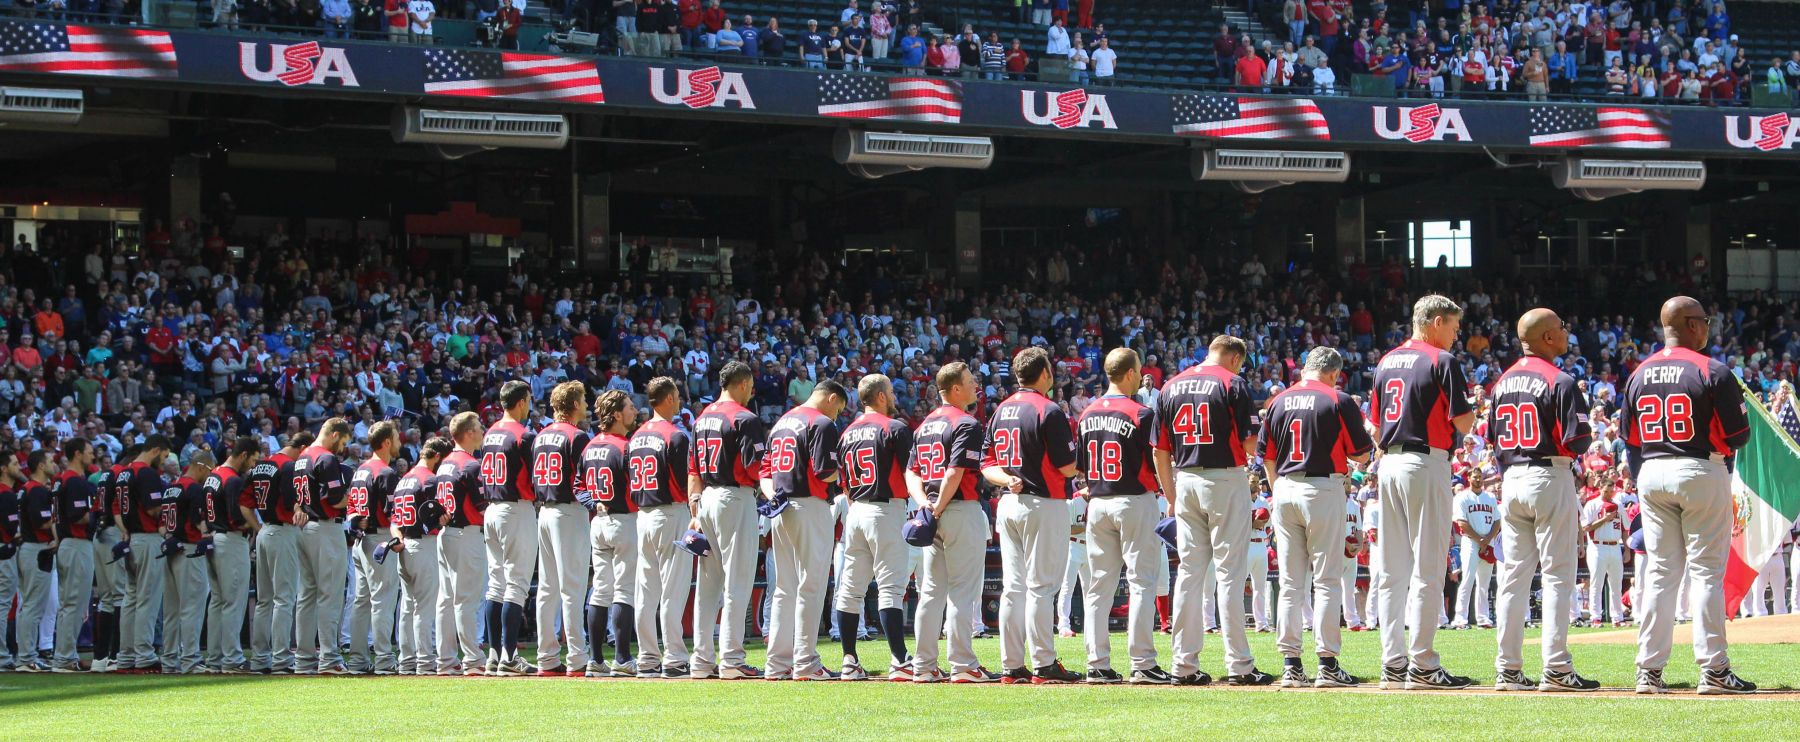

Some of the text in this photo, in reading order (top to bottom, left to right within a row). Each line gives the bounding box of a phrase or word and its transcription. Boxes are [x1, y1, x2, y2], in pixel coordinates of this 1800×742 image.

[239, 41, 360, 86] USA
[648, 66, 756, 109] USA
[1021, 88, 1118, 129] USA
[1372, 103, 1473, 143] USA
[1169, 379, 1218, 397] AFFELDT
[1644, 366, 1684, 385] PERRY
[1001, 406, 1021, 420] BELL
[1284, 395, 1316, 411] BOWA
[1384, 378, 1405, 422] 3
[1637, 393, 1695, 442] 28
[1173, 402, 1214, 445] 41
[1289, 418, 1305, 462] 1
[1496, 402, 1541, 450] 30
[585, 447, 610, 461] DICKEY
[696, 437, 723, 474] 27
[771, 437, 796, 474] 26
[916, 441, 946, 481] 52
[994, 427, 1022, 468] 21
[1087, 439, 1122, 482] 18
[481, 451, 507, 485] 40
[533, 451, 562, 486] 48
[585, 466, 615, 501] 43
[629, 454, 659, 492] 32
[844, 447, 877, 488] 15
[206, 491, 216, 523] 9
[394, 494, 417, 528] 55
